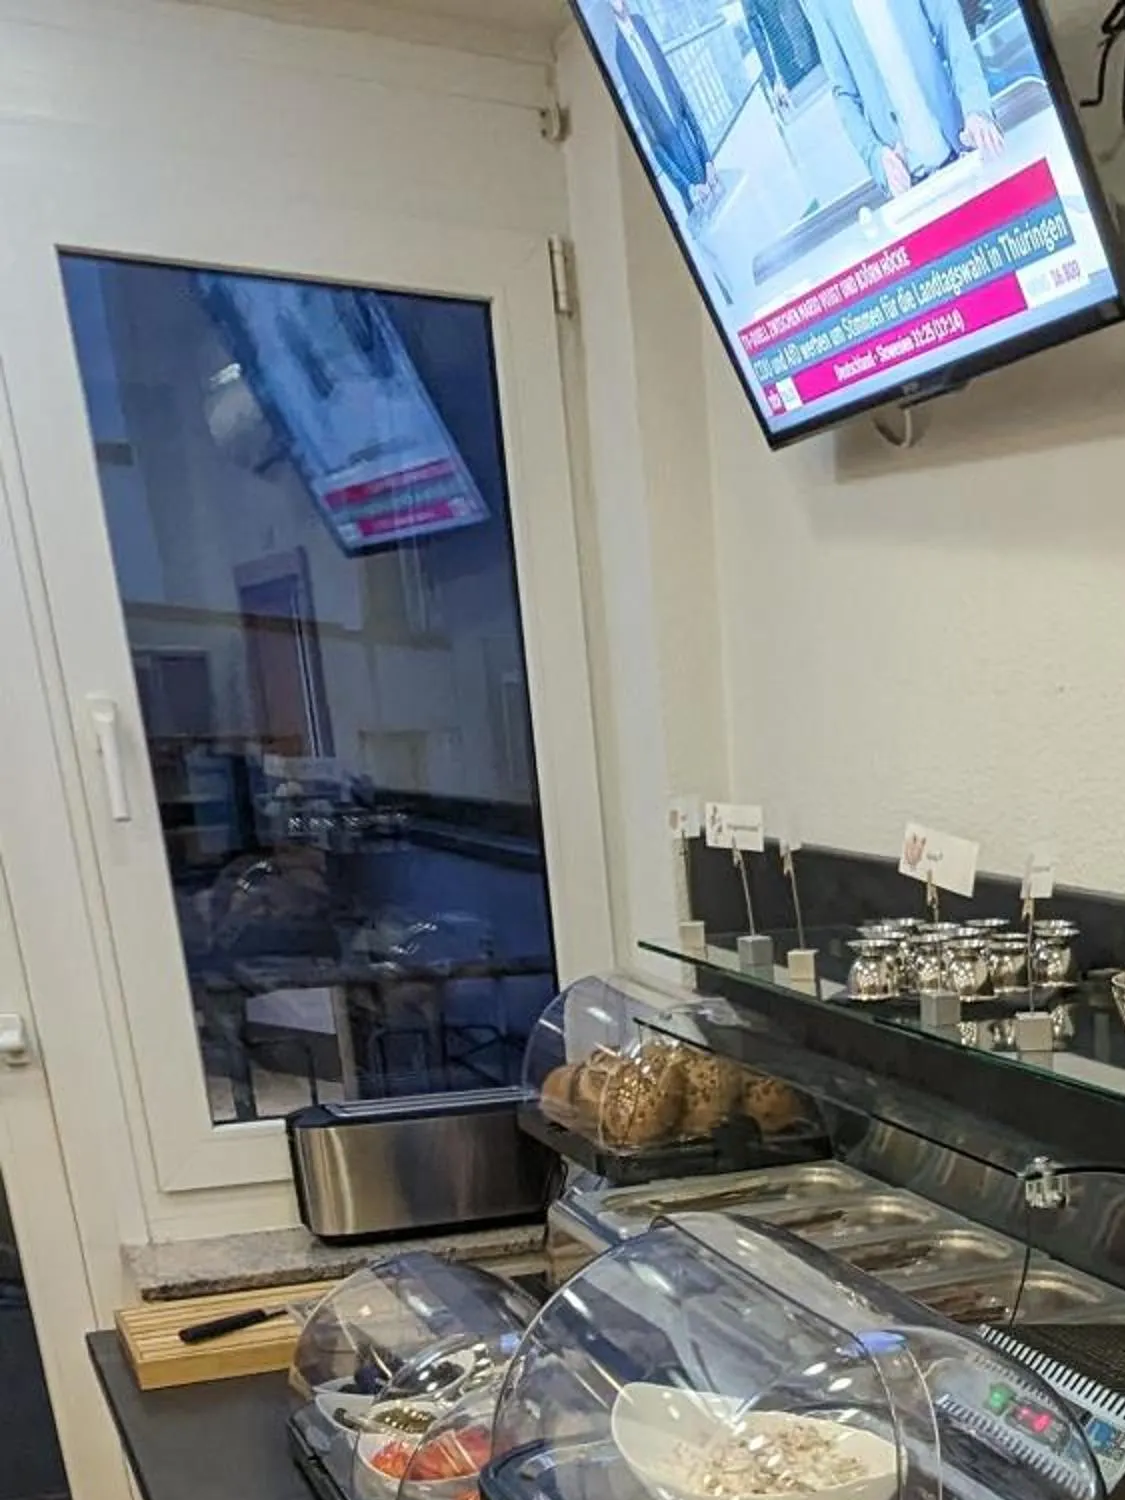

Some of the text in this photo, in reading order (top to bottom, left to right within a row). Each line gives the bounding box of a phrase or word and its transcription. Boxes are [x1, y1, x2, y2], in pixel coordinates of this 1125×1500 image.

[841, 304, 885, 340] Stimmen
[880, 292, 899, 322] für
[897, 285, 918, 314] die
[913, 247, 990, 306] Landtagswahl
[984, 242, 1001, 270] in
[998, 212, 1068, 264] Thüringen
